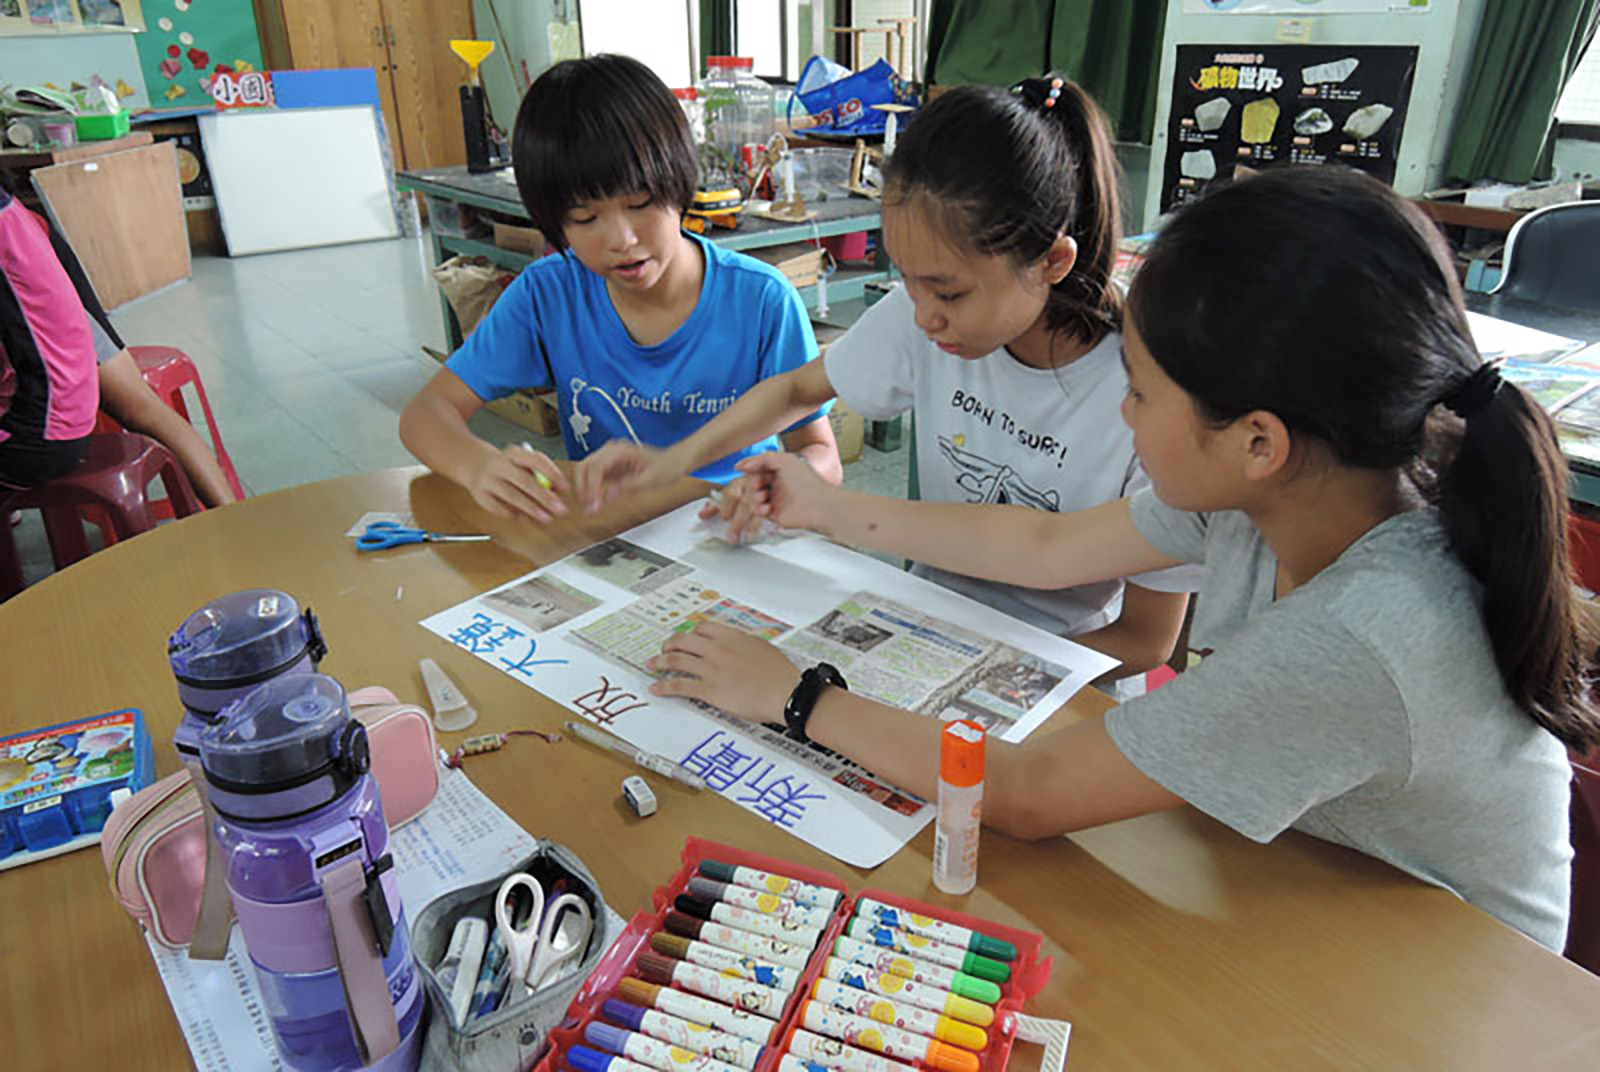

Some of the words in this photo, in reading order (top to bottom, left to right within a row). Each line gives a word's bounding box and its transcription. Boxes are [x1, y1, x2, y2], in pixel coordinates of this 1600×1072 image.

[616, 387, 671, 414] Youth
[682, 389, 738, 414] Tenni
[951, 389, 995, 426] BORN
